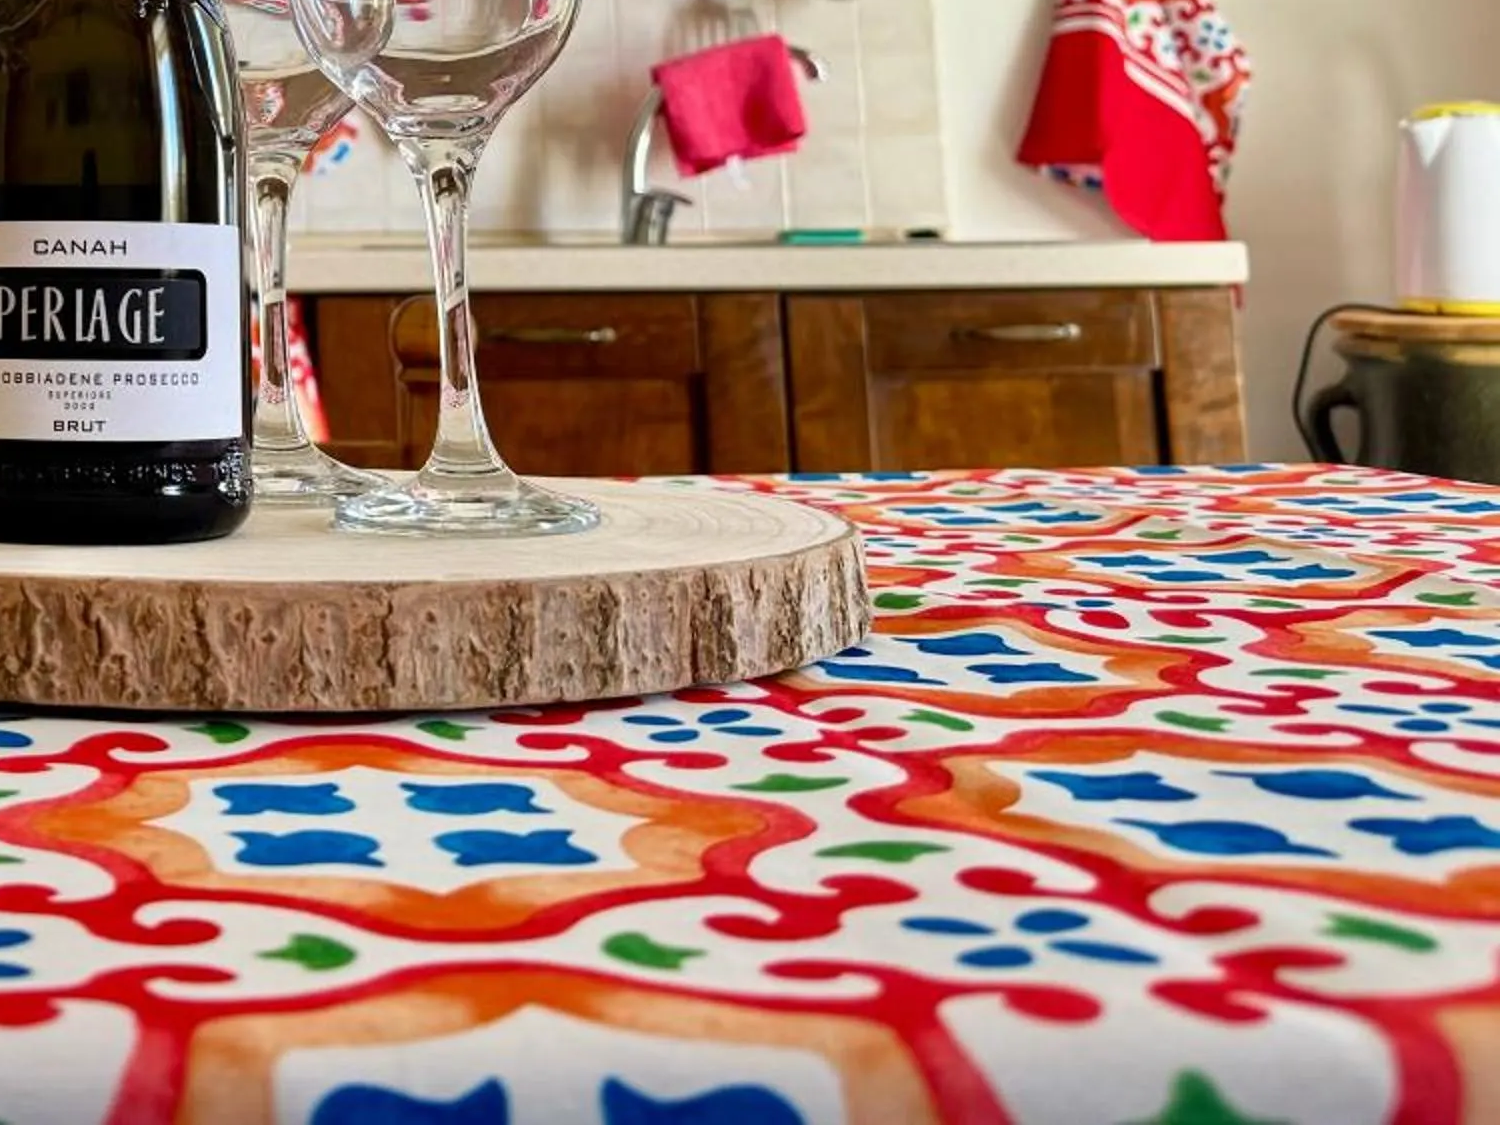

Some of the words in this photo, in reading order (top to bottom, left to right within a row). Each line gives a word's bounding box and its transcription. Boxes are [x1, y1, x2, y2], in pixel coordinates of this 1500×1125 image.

[33, 239, 128, 255] CANAH
[112, 371, 200, 387] PROSECCO
[52, 420, 107, 433] BRUT
